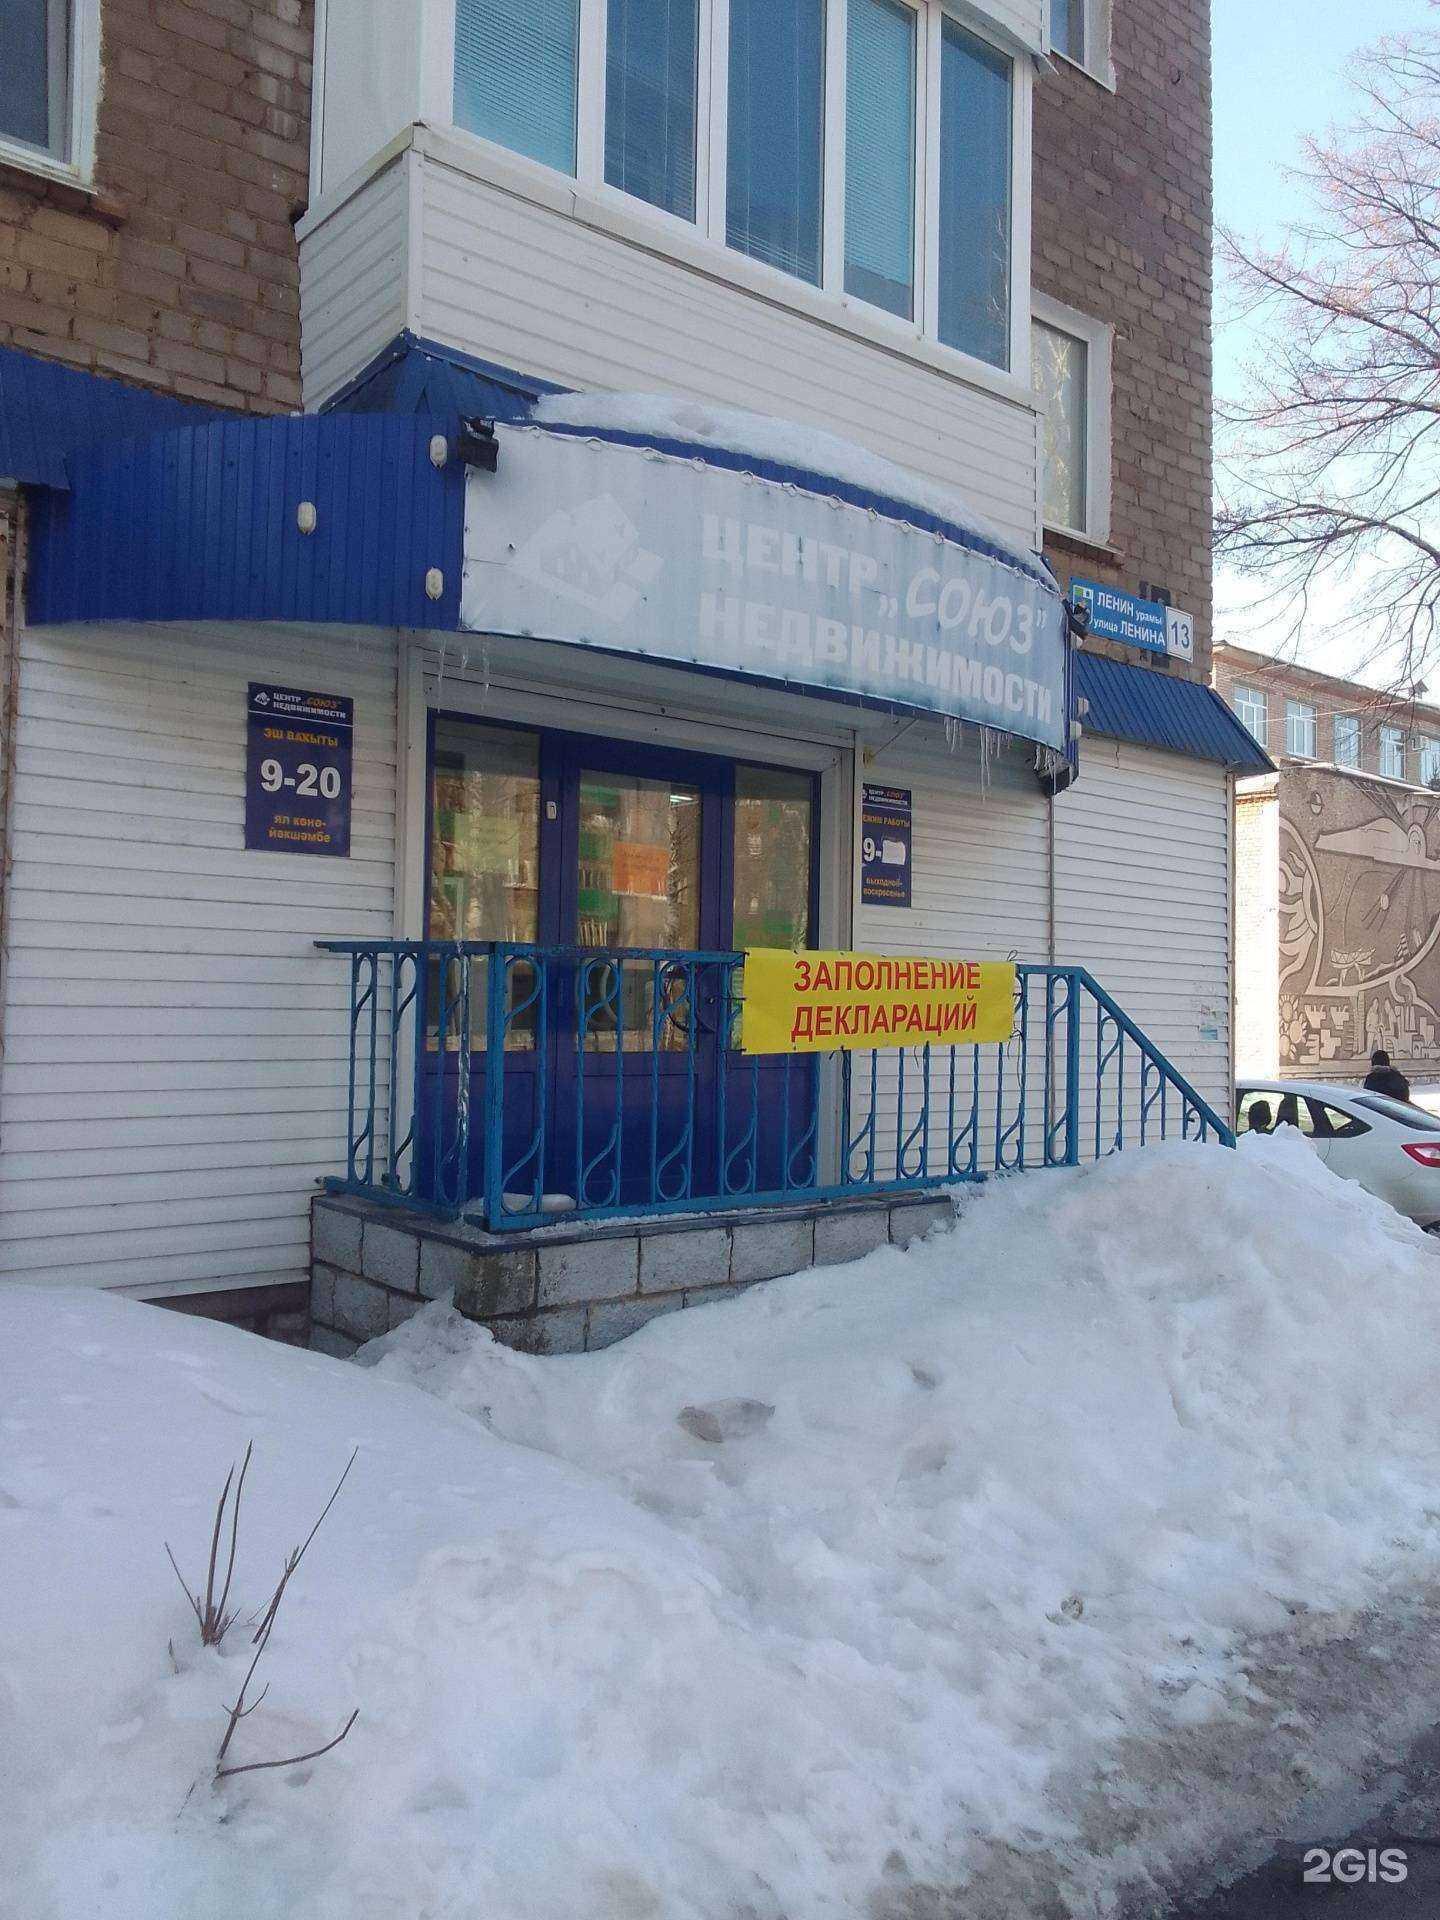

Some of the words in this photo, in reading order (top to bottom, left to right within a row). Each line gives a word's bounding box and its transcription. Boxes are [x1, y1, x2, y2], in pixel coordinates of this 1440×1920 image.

[702, 513, 878, 608] ЦЕНТР
[1096, 591, 1134, 617] ЛЕНИН
[1135, 609, 1162, 626] урамы
[1093, 618, 1118, 634] улица
[1120, 620, 1166, 647] ЛЕНИНА
[1170, 620, 1190, 649] 13
[700, 592, 1052, 722] НЕДВИЖИМОСТИ
[273, 701, 347, 719] НЕДВИЖИМОСТИ
[263, 727, 284, 740] ЭШ
[260, 758, 342, 800] 9-20
[793, 960, 981, 992] ЗАПОЛНЕНИЕ
[791, 994, 978, 1043] ДЕКЛАРАЦИЙ
